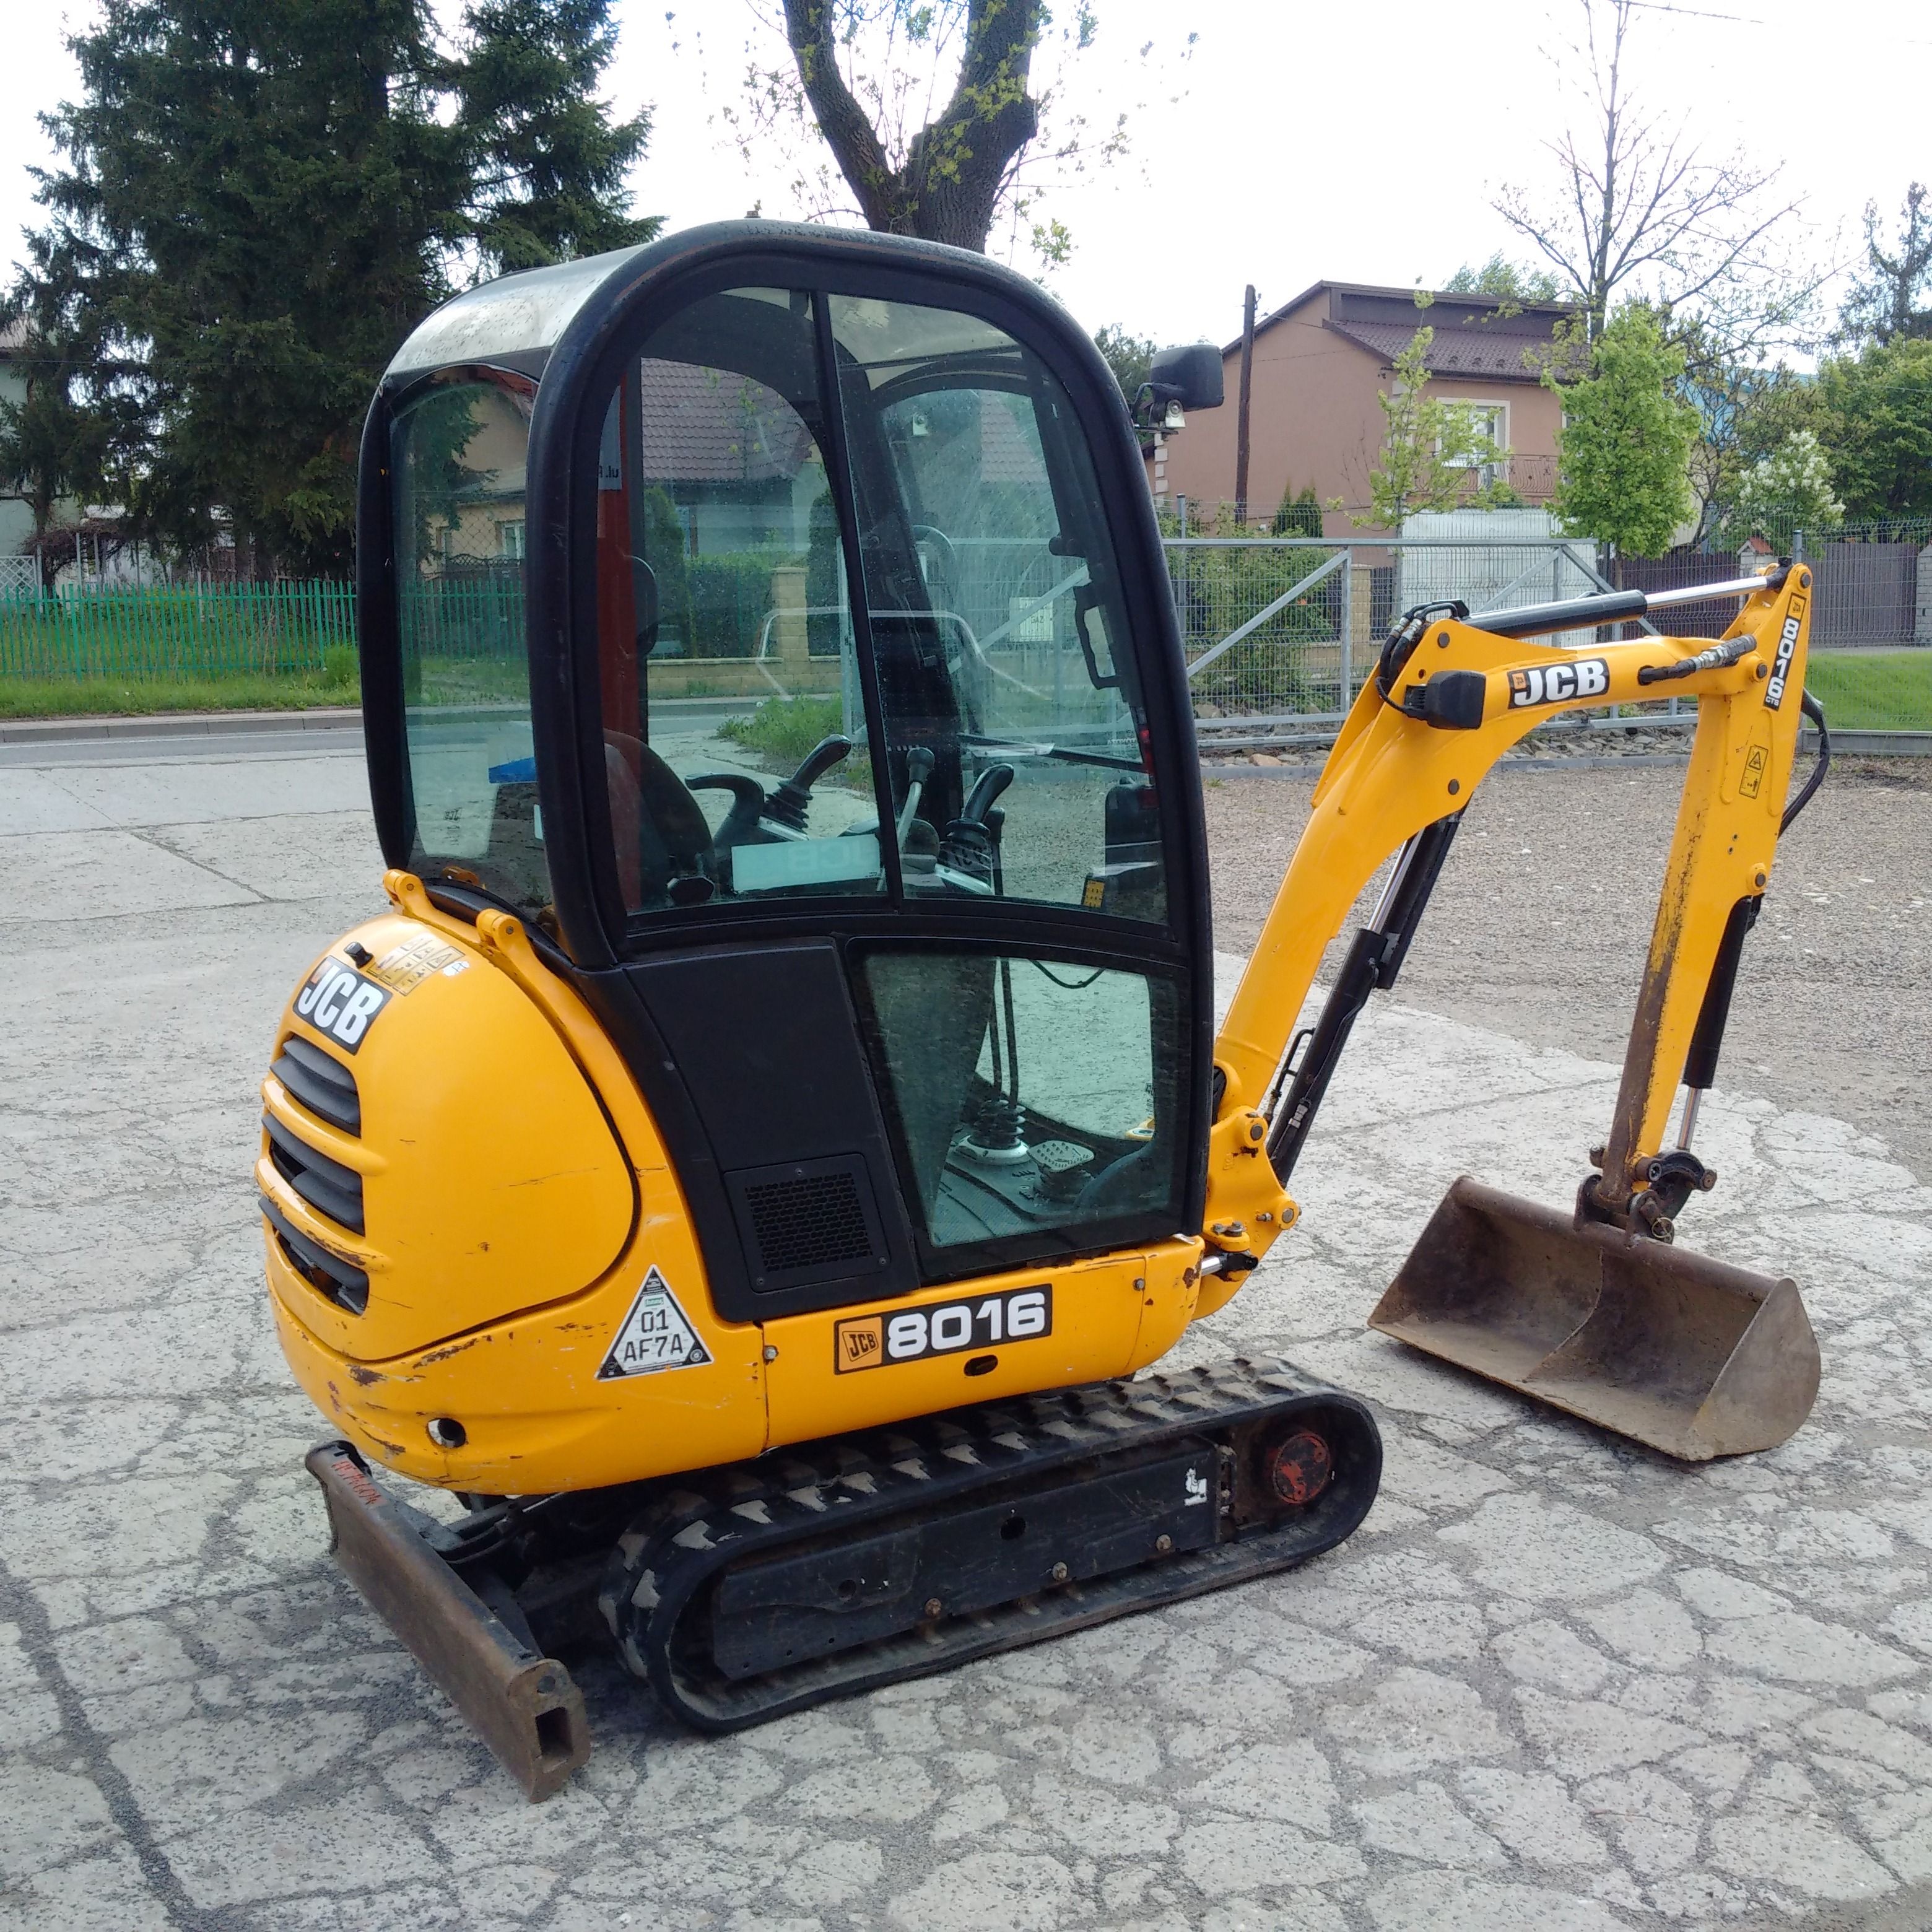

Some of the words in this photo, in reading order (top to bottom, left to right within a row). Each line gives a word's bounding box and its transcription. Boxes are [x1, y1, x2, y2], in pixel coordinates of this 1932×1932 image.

[1767, 617, 1799, 699] 8016
[1514, 661, 1606, 706] JCB
[1765, 695, 1779, 706] CTS
[298, 965, 384, 1045] JCB
[641, 1309, 669, 1333] 01
[849, 1333, 877, 1357] JCB
[887, 1292, 1045, 1358] 8016
[624, 1333, 683, 1362] AF7A
